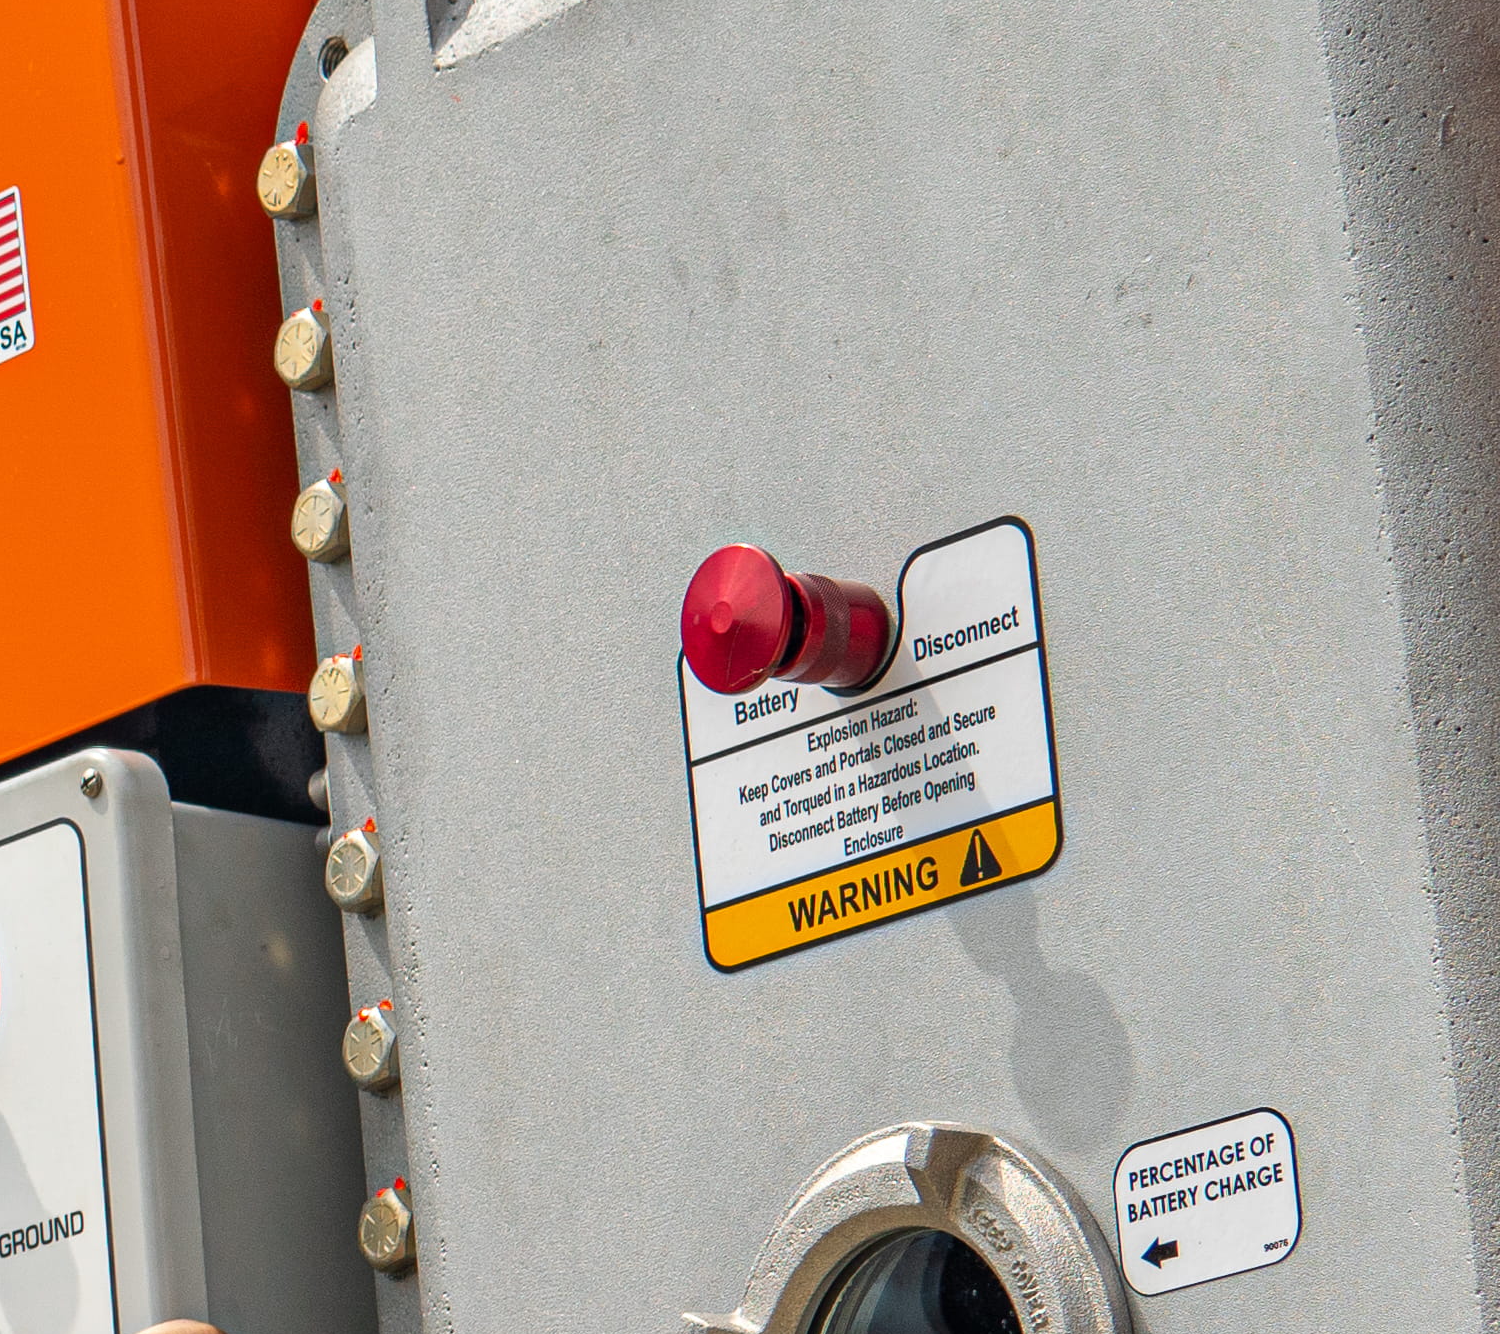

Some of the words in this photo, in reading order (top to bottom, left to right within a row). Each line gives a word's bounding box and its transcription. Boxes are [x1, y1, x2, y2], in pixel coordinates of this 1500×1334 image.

[913, 605, 1019, 662] Disconnect
[734, 687, 800, 726] Battery
[806, 719, 869, 753] Explosion
[869, 698, 919, 733] Hazard:
[738, 782, 769, 808] Keep
[771, 768, 813, 795] Covers
[814, 758, 837, 782] and
[838, 745, 882, 774] Portals
[883, 731, 926, 759] Closed
[927, 719, 952, 743] and
[952, 704, 996, 734] Secure
[759, 806, 782, 828] and
[783, 788, 832, 822] Torqued
[834, 782, 846, 802] in
[847, 784, 856, 799] a
[857, 759, 921, 795] Hazardous
[922, 742, 981, 775] Location.
[768, 818, 835, 853] Disconnect
[836, 798, 879, 831] Battery
[881, 787, 922, 816] Before
[923, 769, 977, 803] Opening
[843, 824, 904, 857] Enclosure
[788, 856, 940, 933] WARNING
[1128, 1140, 1246, 1192] PERCENTAGE
[1250, 1132, 1276, 1157] OF
[1127, 1184, 1199, 1224] BATTERY
[1204, 1162, 1284, 1202] CHARGE
